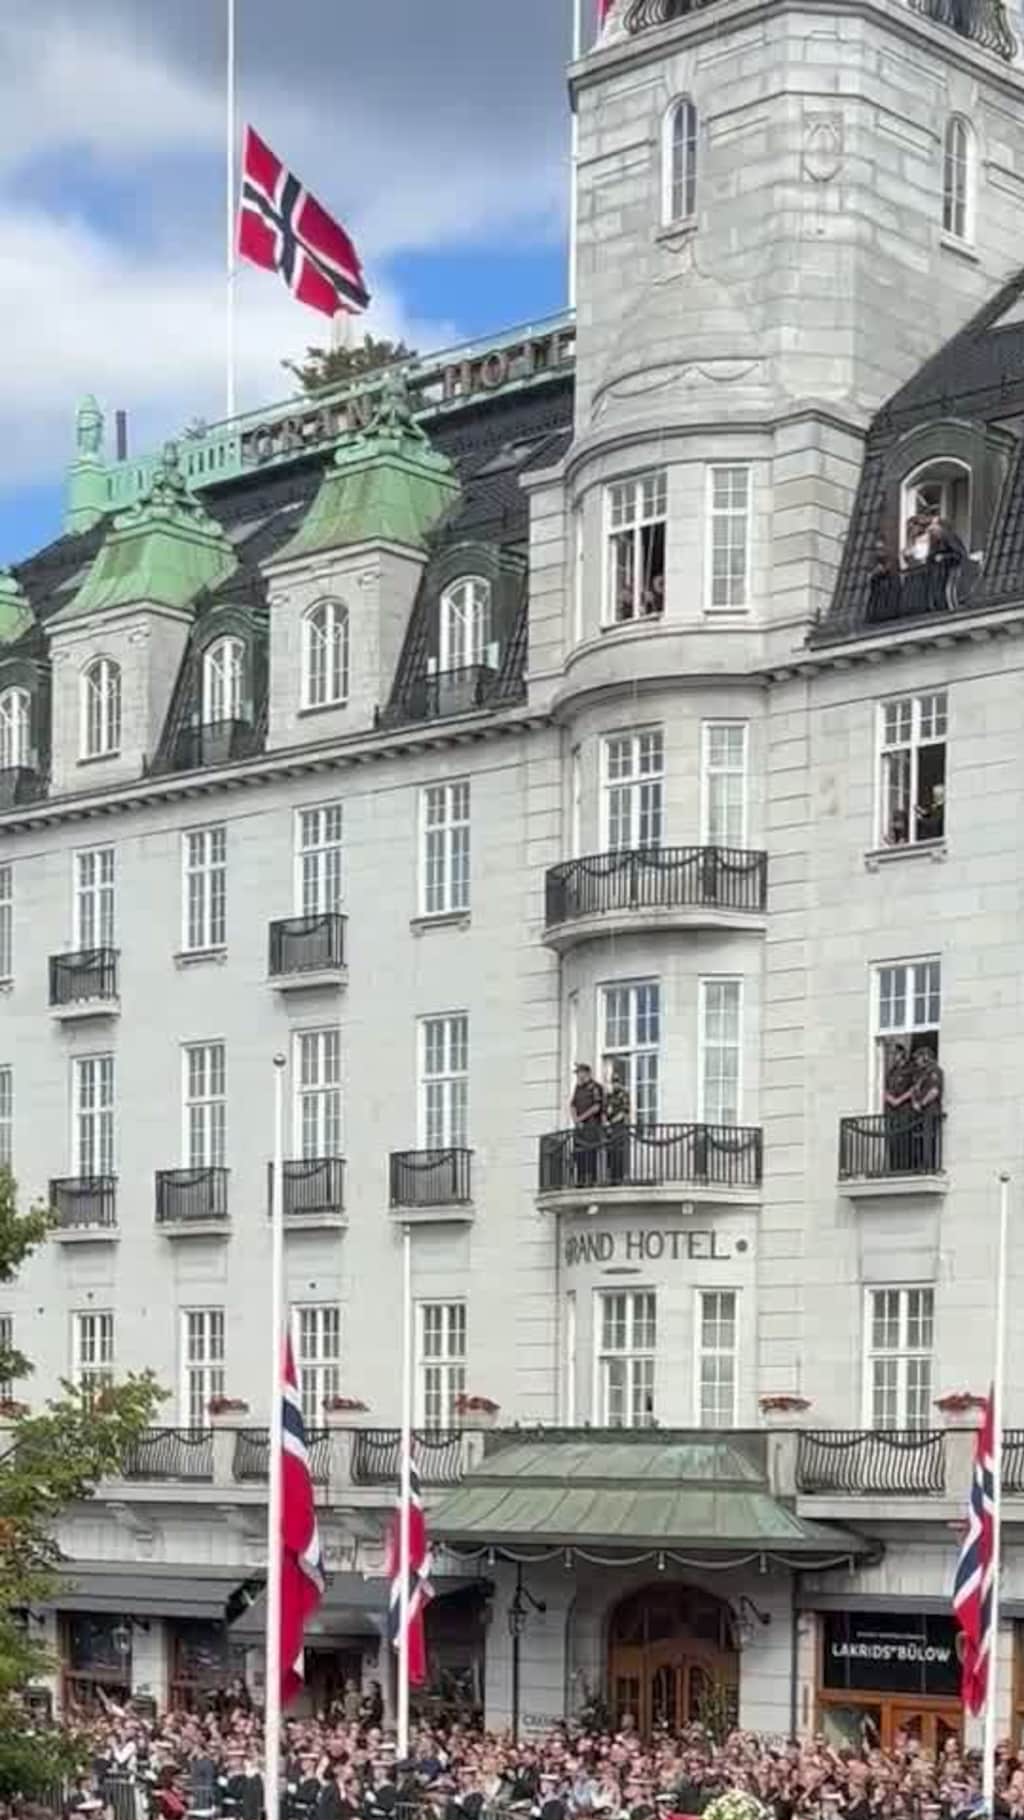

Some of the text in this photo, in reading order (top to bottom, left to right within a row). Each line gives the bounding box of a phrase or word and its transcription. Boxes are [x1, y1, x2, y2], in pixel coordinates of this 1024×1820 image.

[444, 330, 575, 398] HOTE
[625, 1229, 732, 1261] HOTEL
[831, 1642, 891, 1660] LAKRIDS
